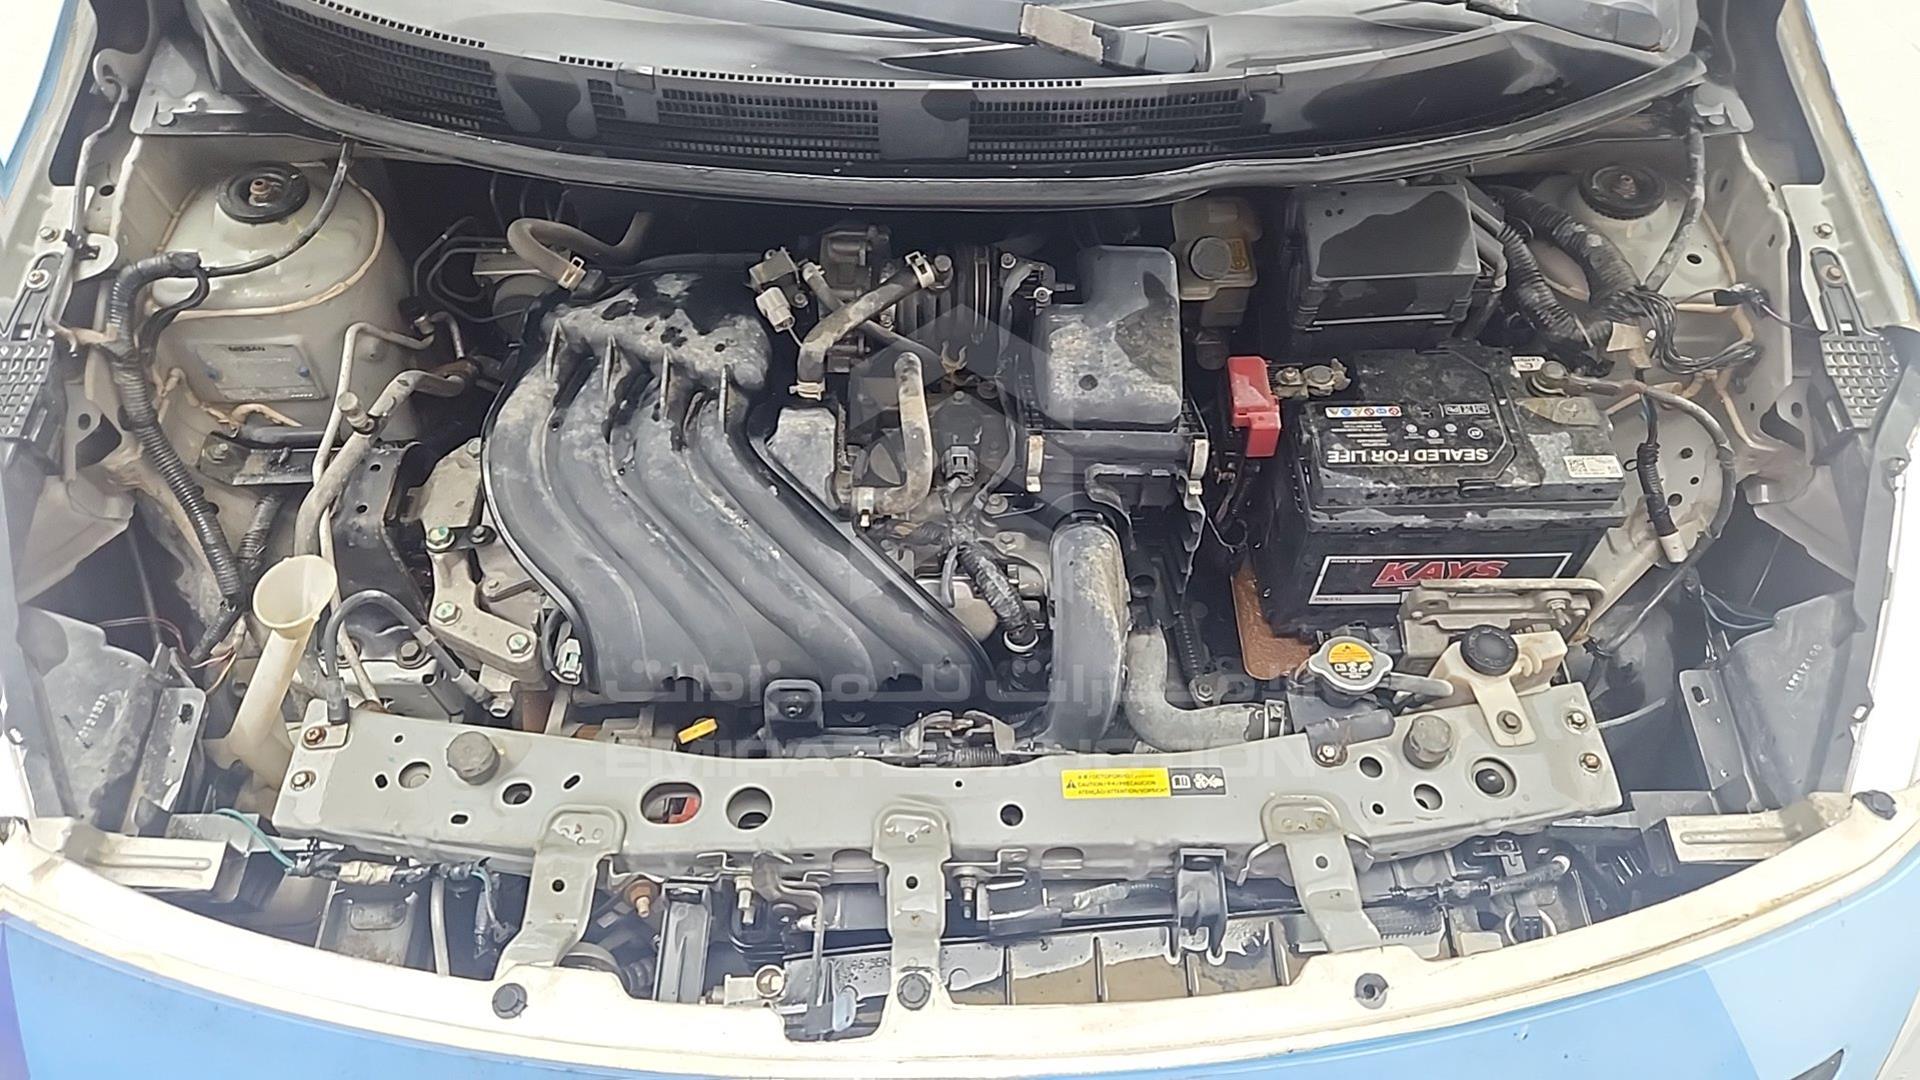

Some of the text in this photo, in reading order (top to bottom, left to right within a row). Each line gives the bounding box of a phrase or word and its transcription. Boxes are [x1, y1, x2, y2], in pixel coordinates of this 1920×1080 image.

[1327, 448, 1489, 463] SEALED FOR LIFE
[1372, 560, 1509, 587] KAYS
